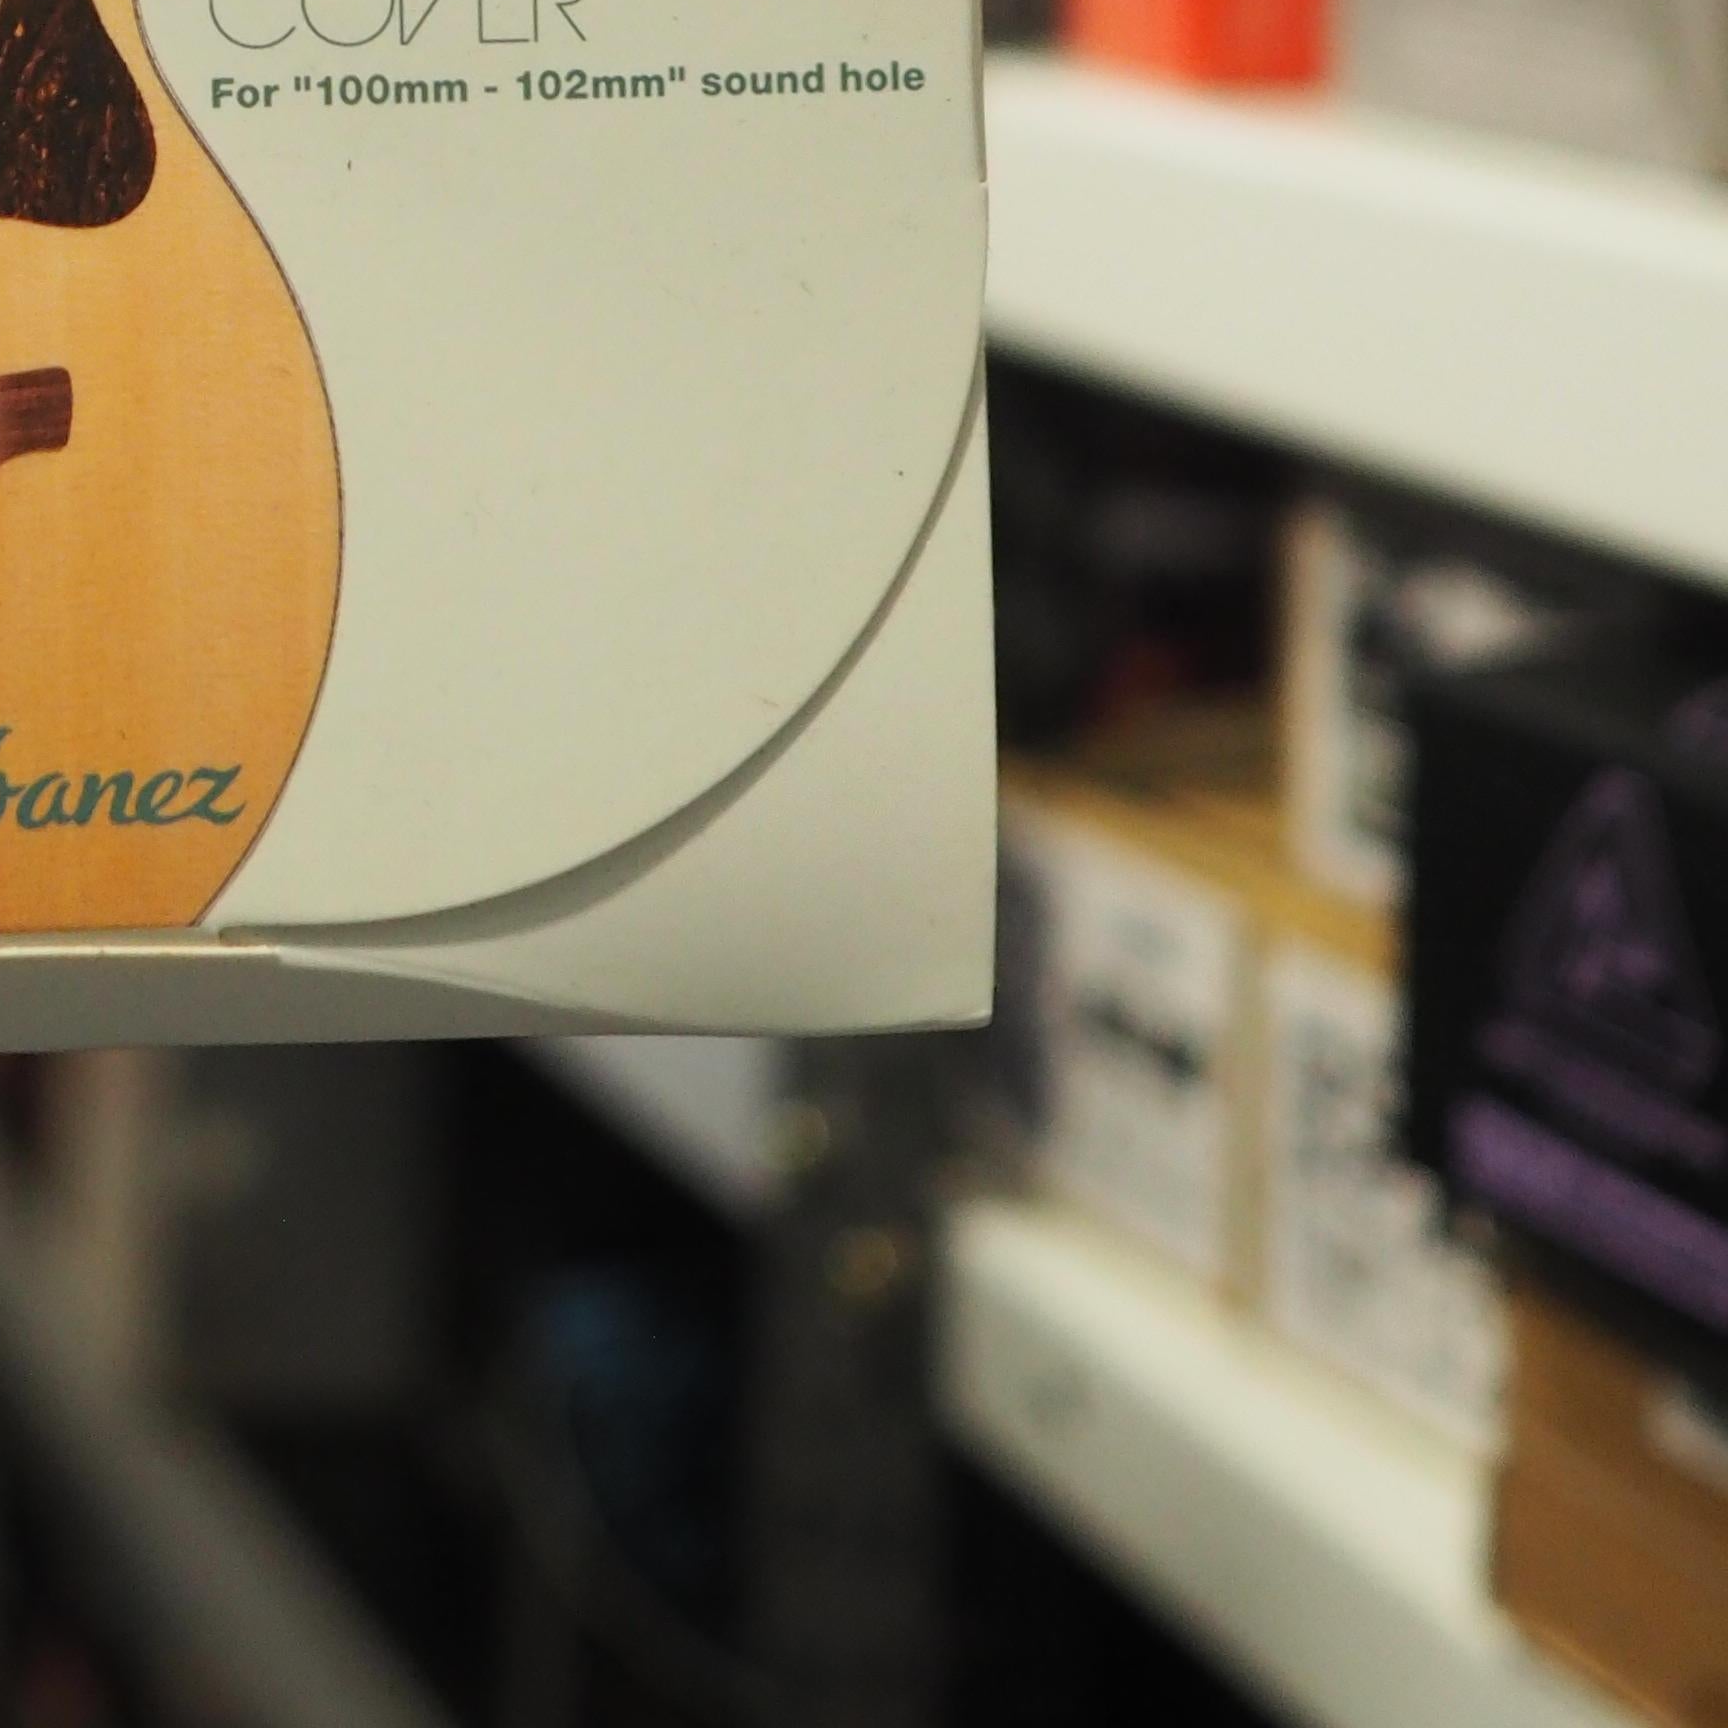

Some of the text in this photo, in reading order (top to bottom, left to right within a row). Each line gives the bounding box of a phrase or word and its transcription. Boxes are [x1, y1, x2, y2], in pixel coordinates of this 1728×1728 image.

[210, 78, 280, 109] For
[293, 73, 469, 107] "100mm
[515, 65, 687, 103] 102mm"
[700, 62, 827, 98] sound
[837, 57, 927, 95] hole
